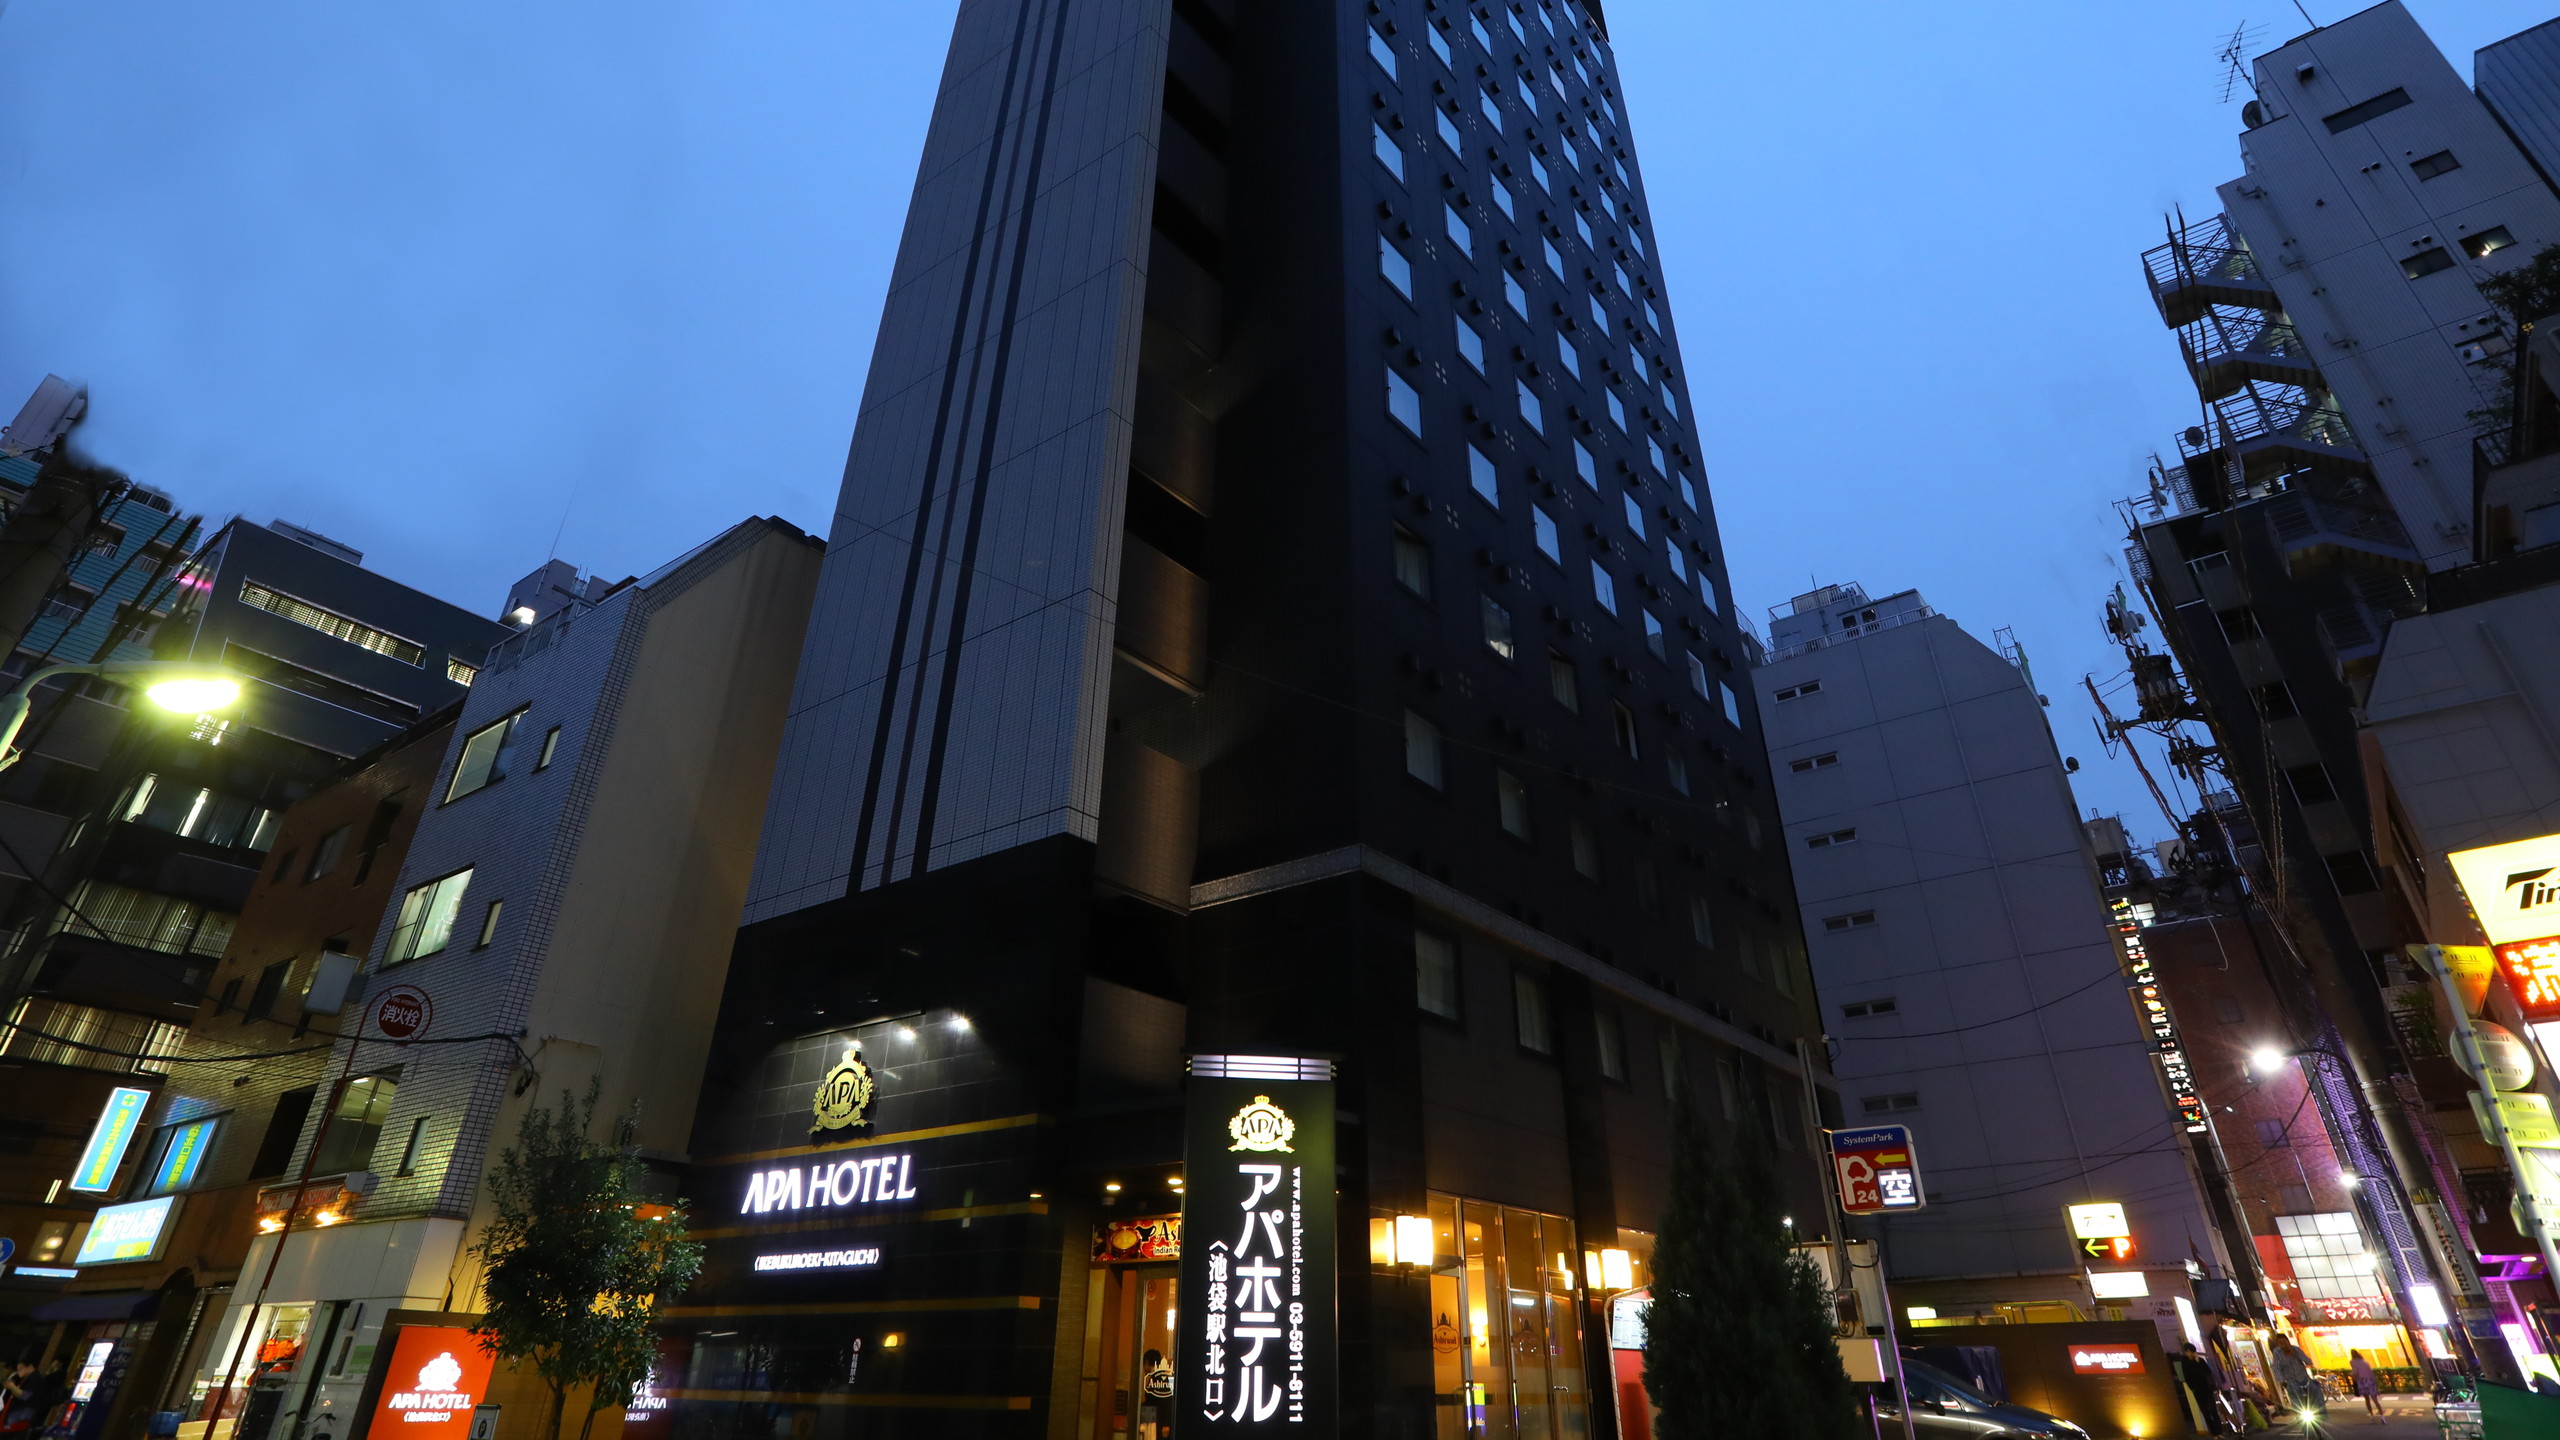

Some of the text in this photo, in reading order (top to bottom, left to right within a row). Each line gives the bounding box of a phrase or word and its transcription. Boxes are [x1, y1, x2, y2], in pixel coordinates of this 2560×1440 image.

[381, 1004, 420, 1028] 消火栓
[1843, 1132, 1894, 1146] SystemPark
[740, 1154, 917, 1214] APA HOTEL
[1879, 1170, 1916, 1205] 空
[1856, 1189, 1879, 1204] 24
[2113, 1237, 2131, 1258] P
[1231, 1164, 1284, 1423] アパホテル
[1288, 1166, 1304, 1423] www.apahotel.com 03-5911-8111
[2325, 1308, 2372, 1320] マックス
[388, 1393, 472, 1410] APA HOTEL
